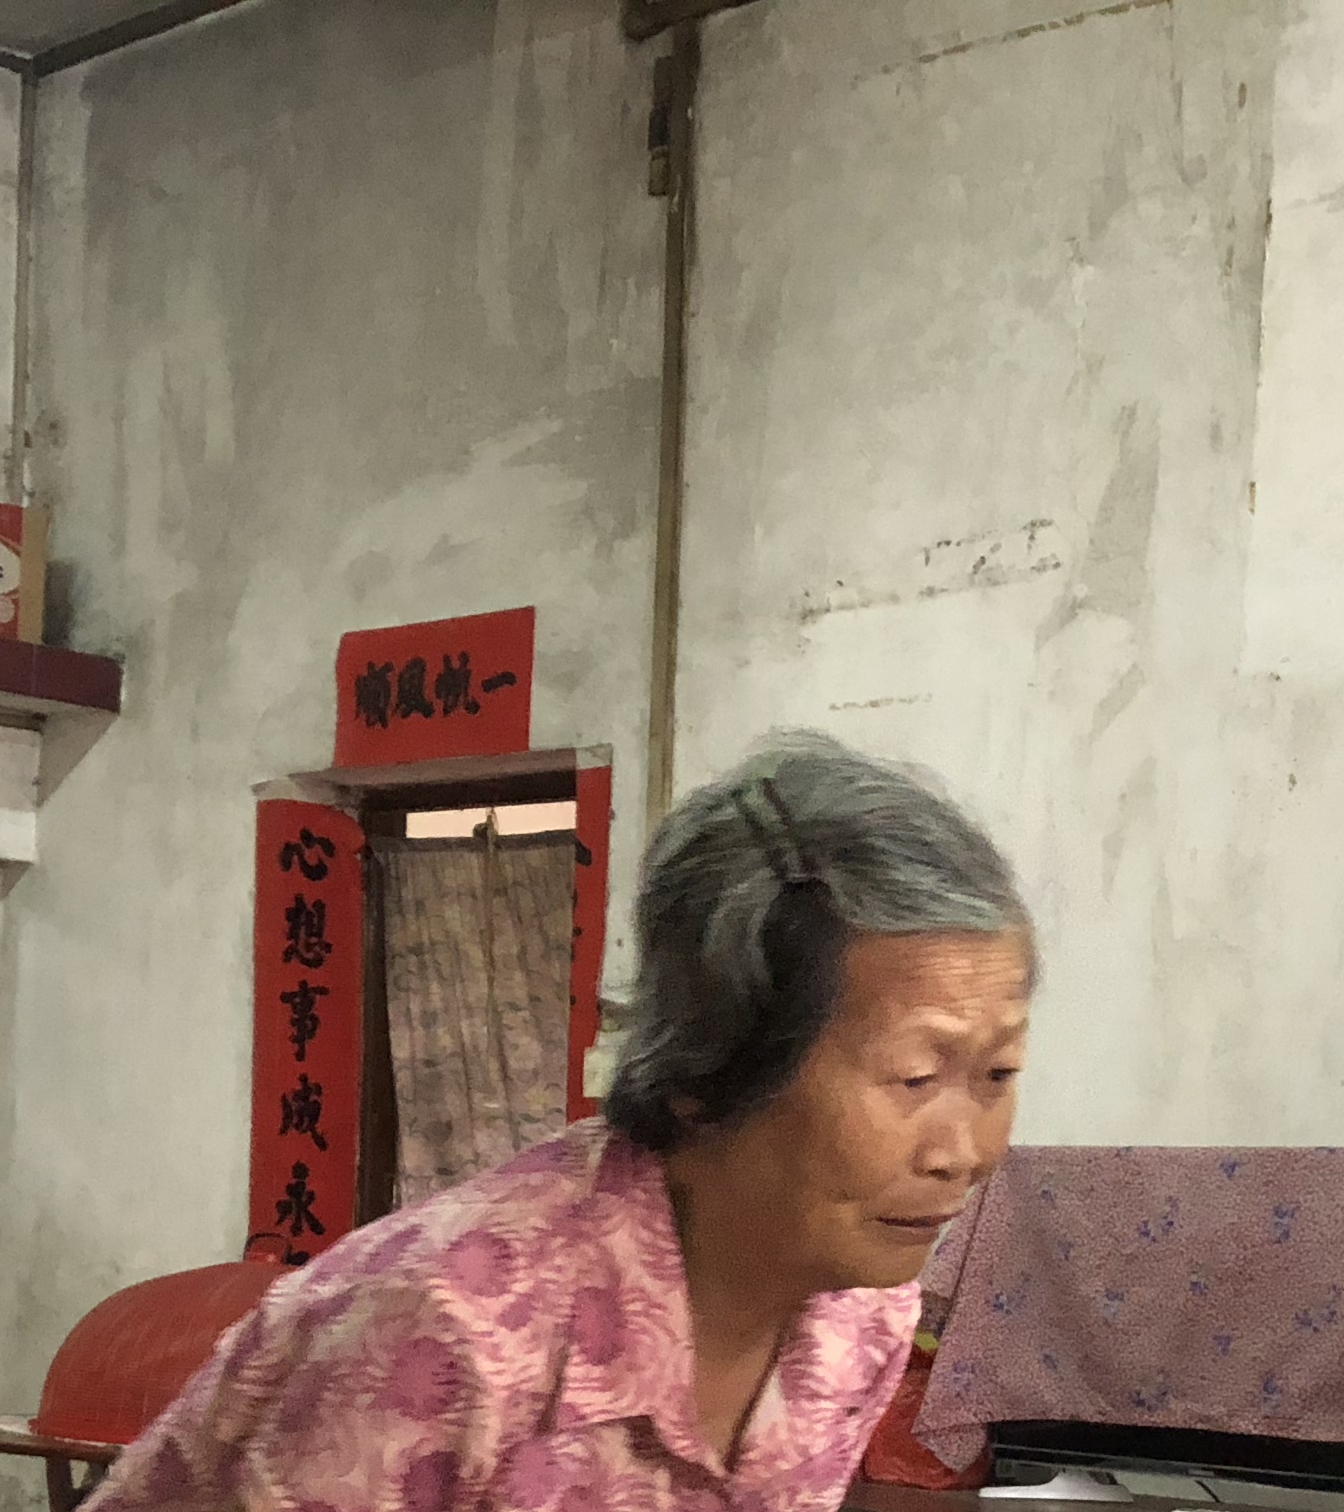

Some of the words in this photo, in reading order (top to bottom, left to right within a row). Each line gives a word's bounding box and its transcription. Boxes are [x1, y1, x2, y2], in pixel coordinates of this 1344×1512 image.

[274, 827, 336, 1266] 心想事成永
